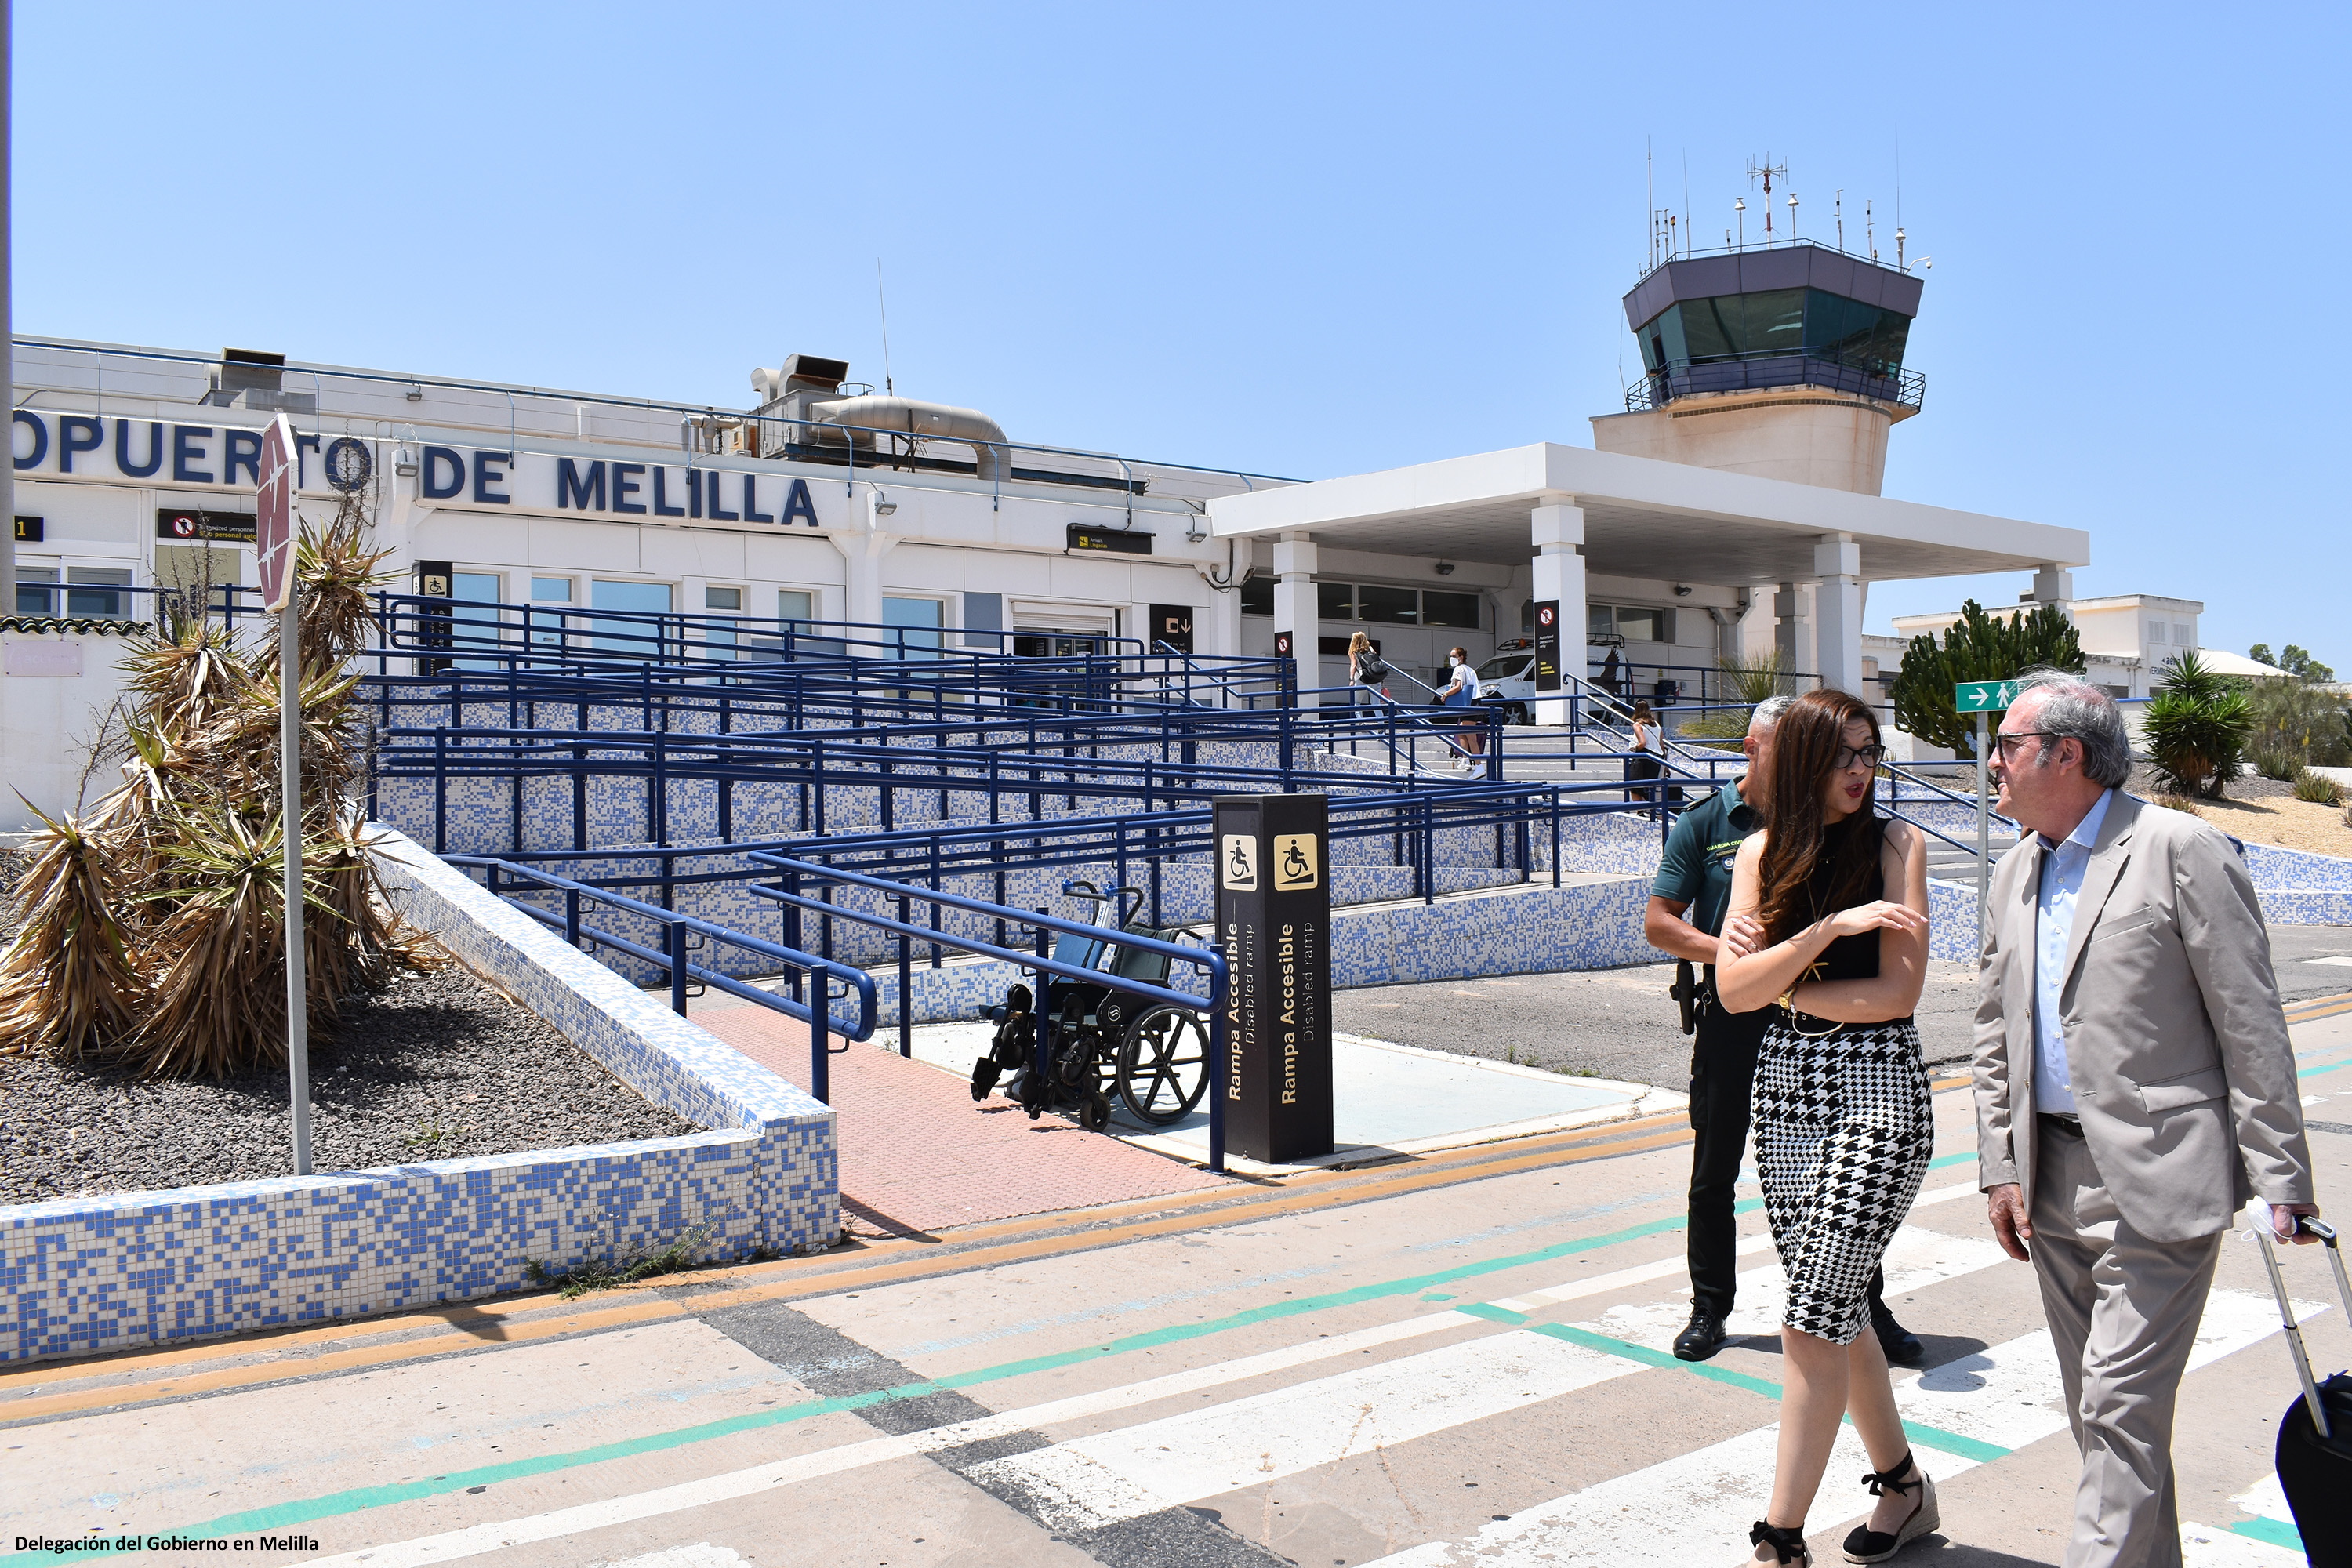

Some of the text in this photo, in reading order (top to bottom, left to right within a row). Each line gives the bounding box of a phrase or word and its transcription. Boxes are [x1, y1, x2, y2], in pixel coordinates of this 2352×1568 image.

[17, 521, 26, 536] 1
[423, 446, 510, 504] DE
[558, 458, 818, 527] MELILLA
[1706, 842, 1730, 851] GUARDIA
[1226, 923, 1243, 1101] Rampa Accesible
[1245, 924, 1254, 1044] Disabled ramp
[1279, 924, 1299, 1105] Rampa Accesible
[1303, 921, 1314, 1041] Disabled ramp
